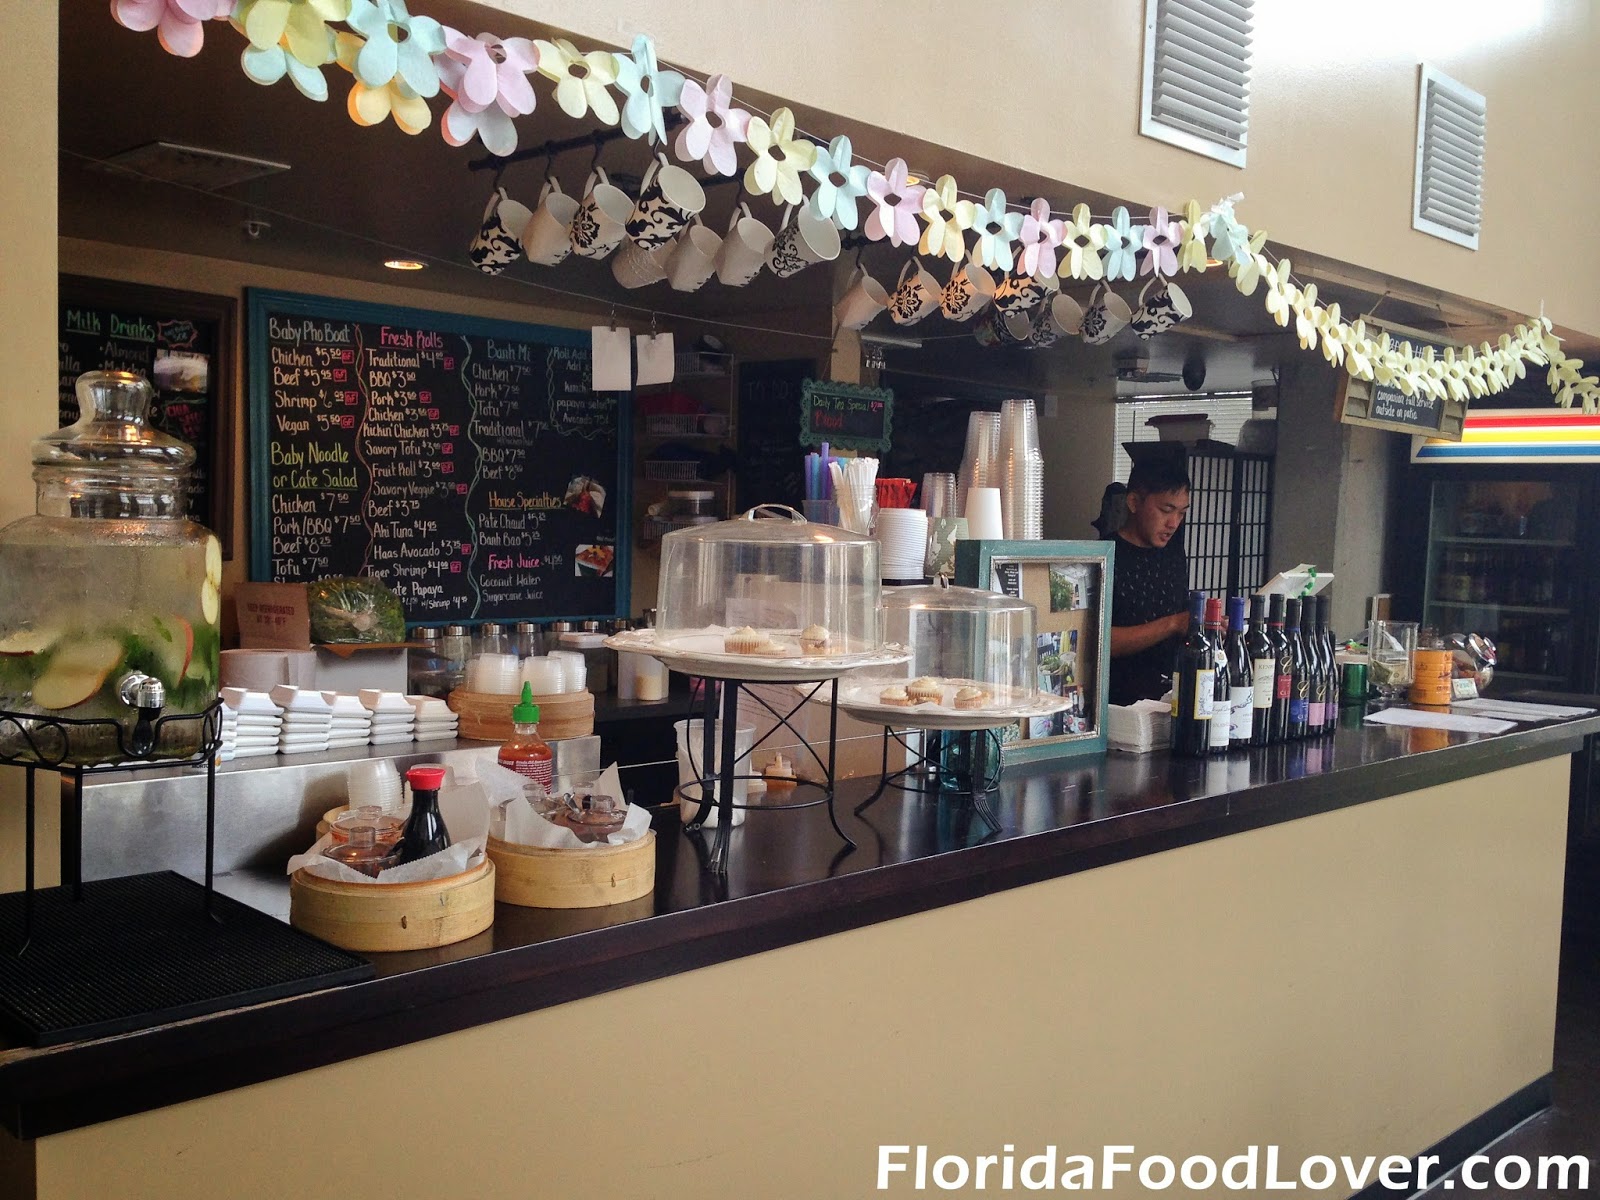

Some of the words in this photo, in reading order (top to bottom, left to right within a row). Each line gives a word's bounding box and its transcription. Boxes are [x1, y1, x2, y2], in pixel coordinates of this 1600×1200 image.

[67, 309, 100, 331] Milk
[110, 313, 155, 339] Drinks
[269, 318, 301, 346] Baby
[303, 321, 324, 341] Pho
[325, 323, 351, 343] Boat
[381, 326, 413, 348] Fresh
[416, 330, 444, 349] Rolls
[271, 347, 314, 367] Chicken
[365, 348, 420, 368] Traditional
[487, 339, 516, 360] Banh
[274, 366, 301, 387] Beef
[369, 371, 391, 388] BBQ
[472, 363, 509, 381] Chicken
[371, 391, 394, 406] Pork
[475, 383, 498, 398] Pork
[275, 390, 317, 413] Shrimp
[477, 400, 499, 416] Tofu
[813, 395, 831, 413] Daily
[832, 397, 845, 411] Tea
[847, 398, 870, 415] Special
[1375, 402, 1395, 418] outside
[1396, 408, 1403, 418] on
[368, 407, 404, 421] Chicken
[276, 415, 310, 436] Vegan
[394, 423, 429, 438] Chicken
[473, 420, 526, 439] Traditional
[271, 441, 304, 470] Baby
[308, 441, 349, 464] Noodle
[365, 440, 397, 458] Savory
[399, 440, 421, 456] Tofu
[482, 447, 504, 463] BBQ
[372, 462, 396, 477] Fruit
[398, 460, 417, 477] Roll
[482, 465, 503, 480] Beef
[273, 476, 288, 488] or
[291, 469, 318, 488] Cafe
[322, 468, 358, 488] Salad
[373, 481, 407, 499] Savory
[408, 481, 435, 498] Veggie
[271, 493, 317, 514] Chicken
[368, 499, 393, 517] Beef
[488, 491, 516, 508] House
[516, 491, 562, 512] Specialties
[373, 522, 390, 537] Ahi
[390, 521, 413, 538] Tuna
[499, 513, 526, 530] Chaud
[273, 536, 302, 555] Beef
[479, 532, 501, 547] Banh
[502, 532, 521, 547] Bao
[374, 545, 399, 560] Haas
[400, 541, 440, 559] Avocado
[272, 558, 301, 576] Tofu
[488, 553, 513, 571] Fresh
[516, 553, 540, 569] Juice
[365, 564, 391, 580] Tiger
[393, 563, 428, 579] Shrimp
[412, 581, 444, 599] Papaya
[479, 574, 513, 588] Coconut
[516, 575, 541, 588] Water
[482, 589, 522, 606] Sugarcane
[524, 589, 544, 601] Juice
